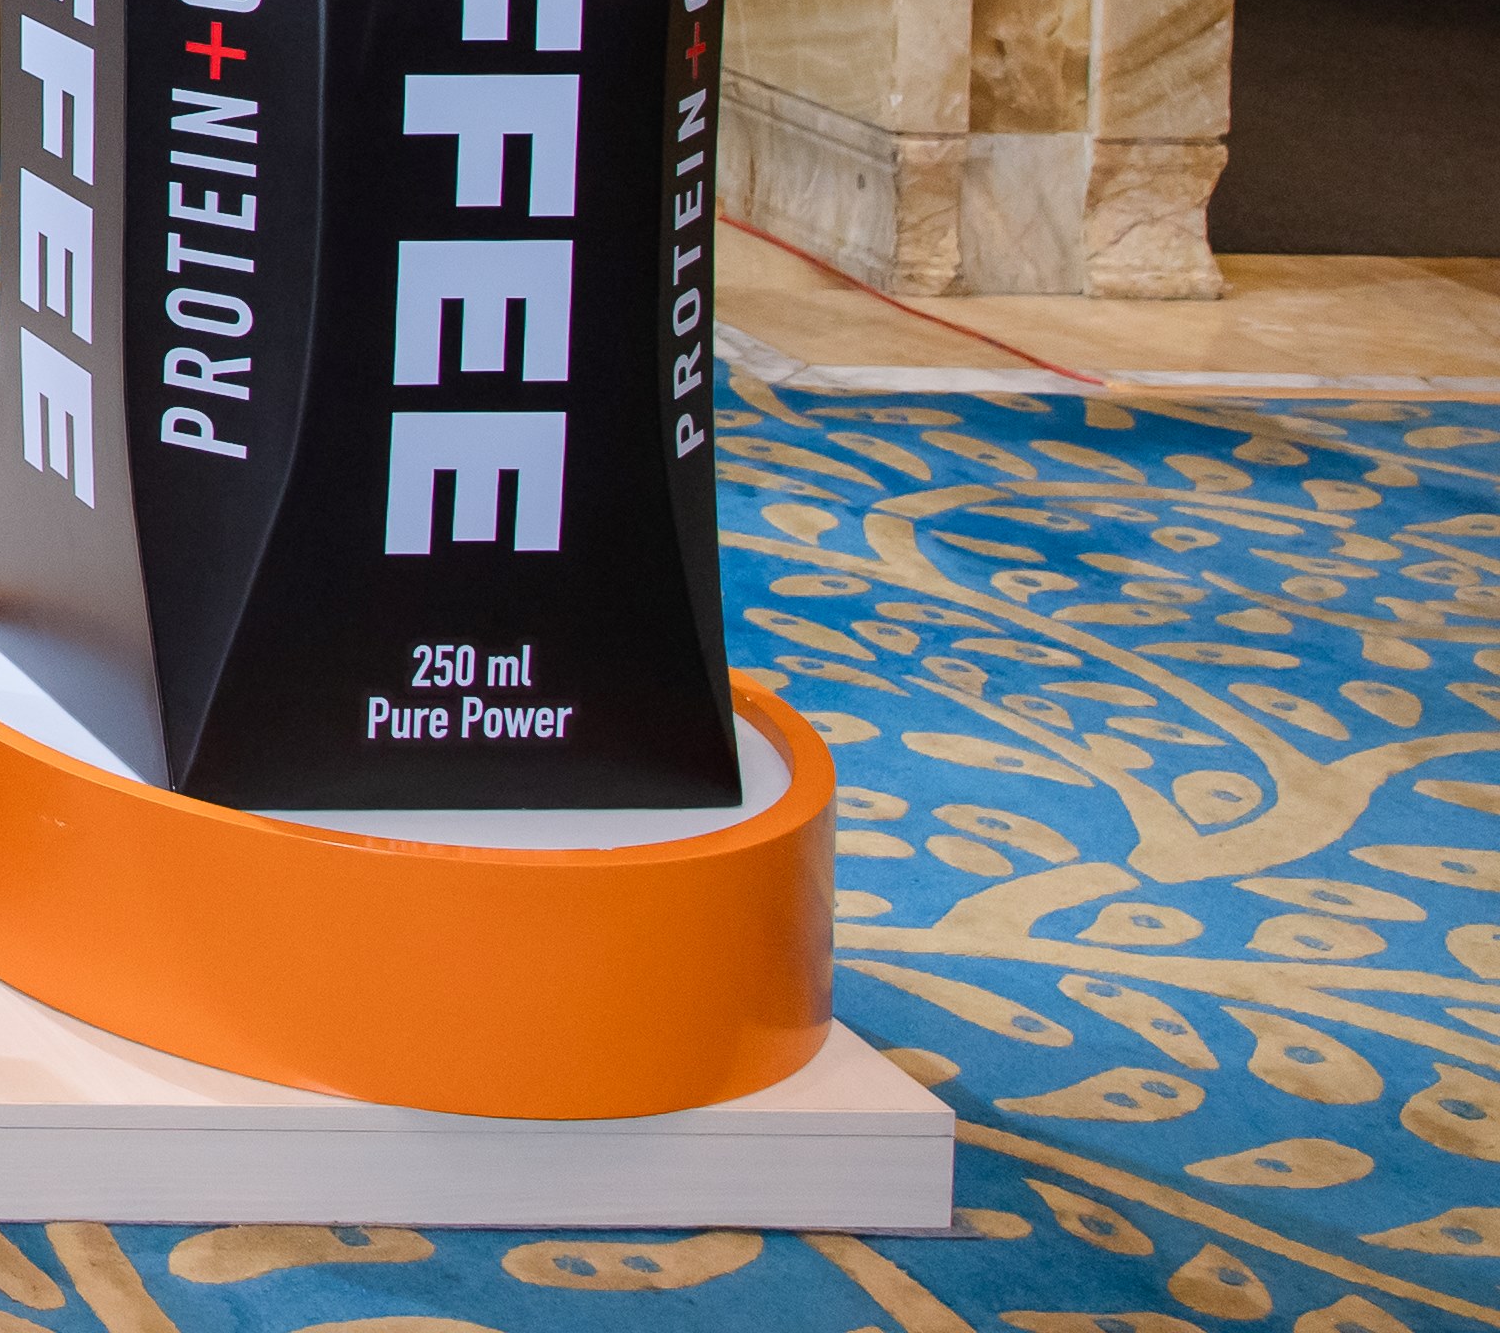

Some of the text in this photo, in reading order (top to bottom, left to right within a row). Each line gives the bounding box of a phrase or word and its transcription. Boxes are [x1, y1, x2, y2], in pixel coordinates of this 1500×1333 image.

[411, 644, 532, 687] 250 ml
[367, 696, 573, 739] Pure Power
